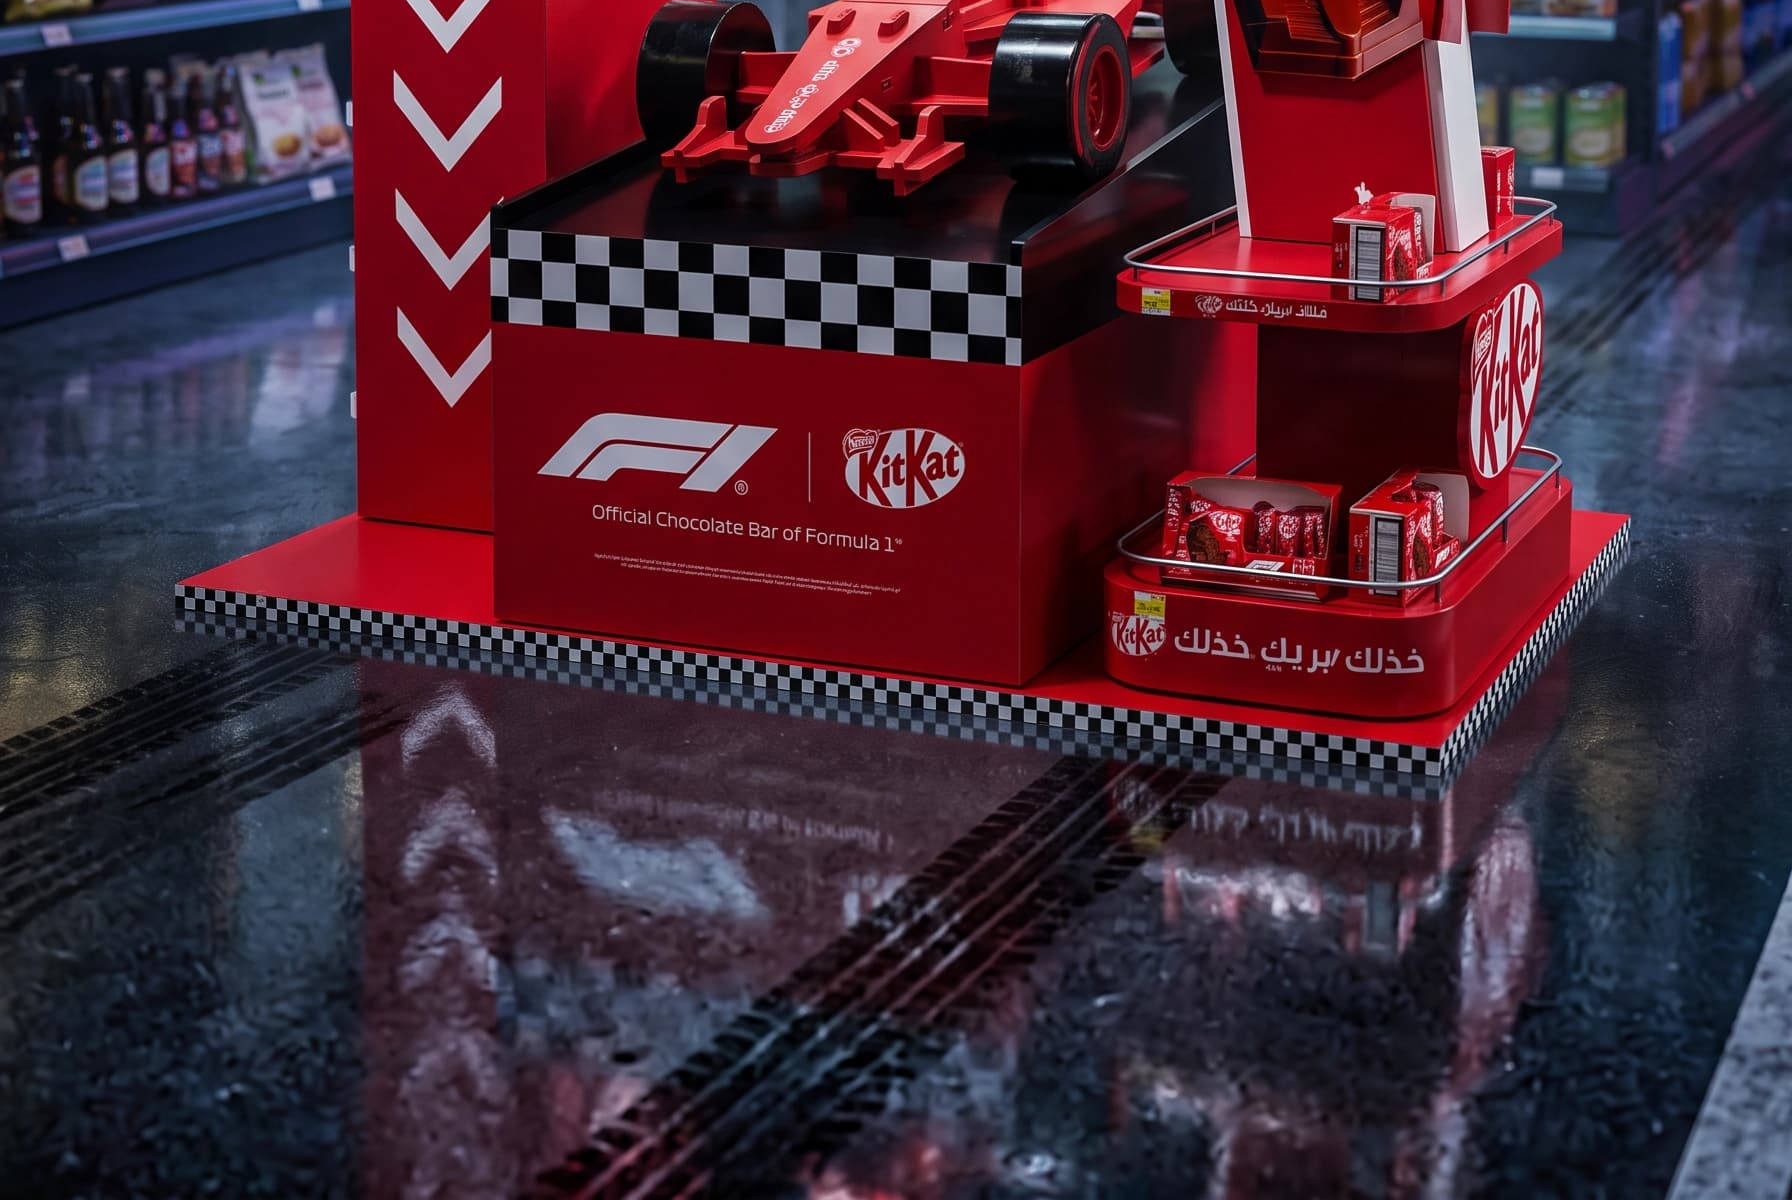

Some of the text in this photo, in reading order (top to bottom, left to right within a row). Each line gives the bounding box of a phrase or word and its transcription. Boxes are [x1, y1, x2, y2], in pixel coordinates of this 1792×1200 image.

[1478, 285, 1540, 475] KitKat
[858, 429, 960, 507] KitKat
[592, 504, 652, 526] Official
[655, 511, 744, 536] Chocolate
[748, 521, 779, 540] Bar
[782, 526, 802, 542] of
[805, 528, 880, 551] Formula
[1116, 616, 1165, 656] KitKat
[1173, 628, 1250, 660] خذلك
[1345, 646, 1425, 674] خذلك
